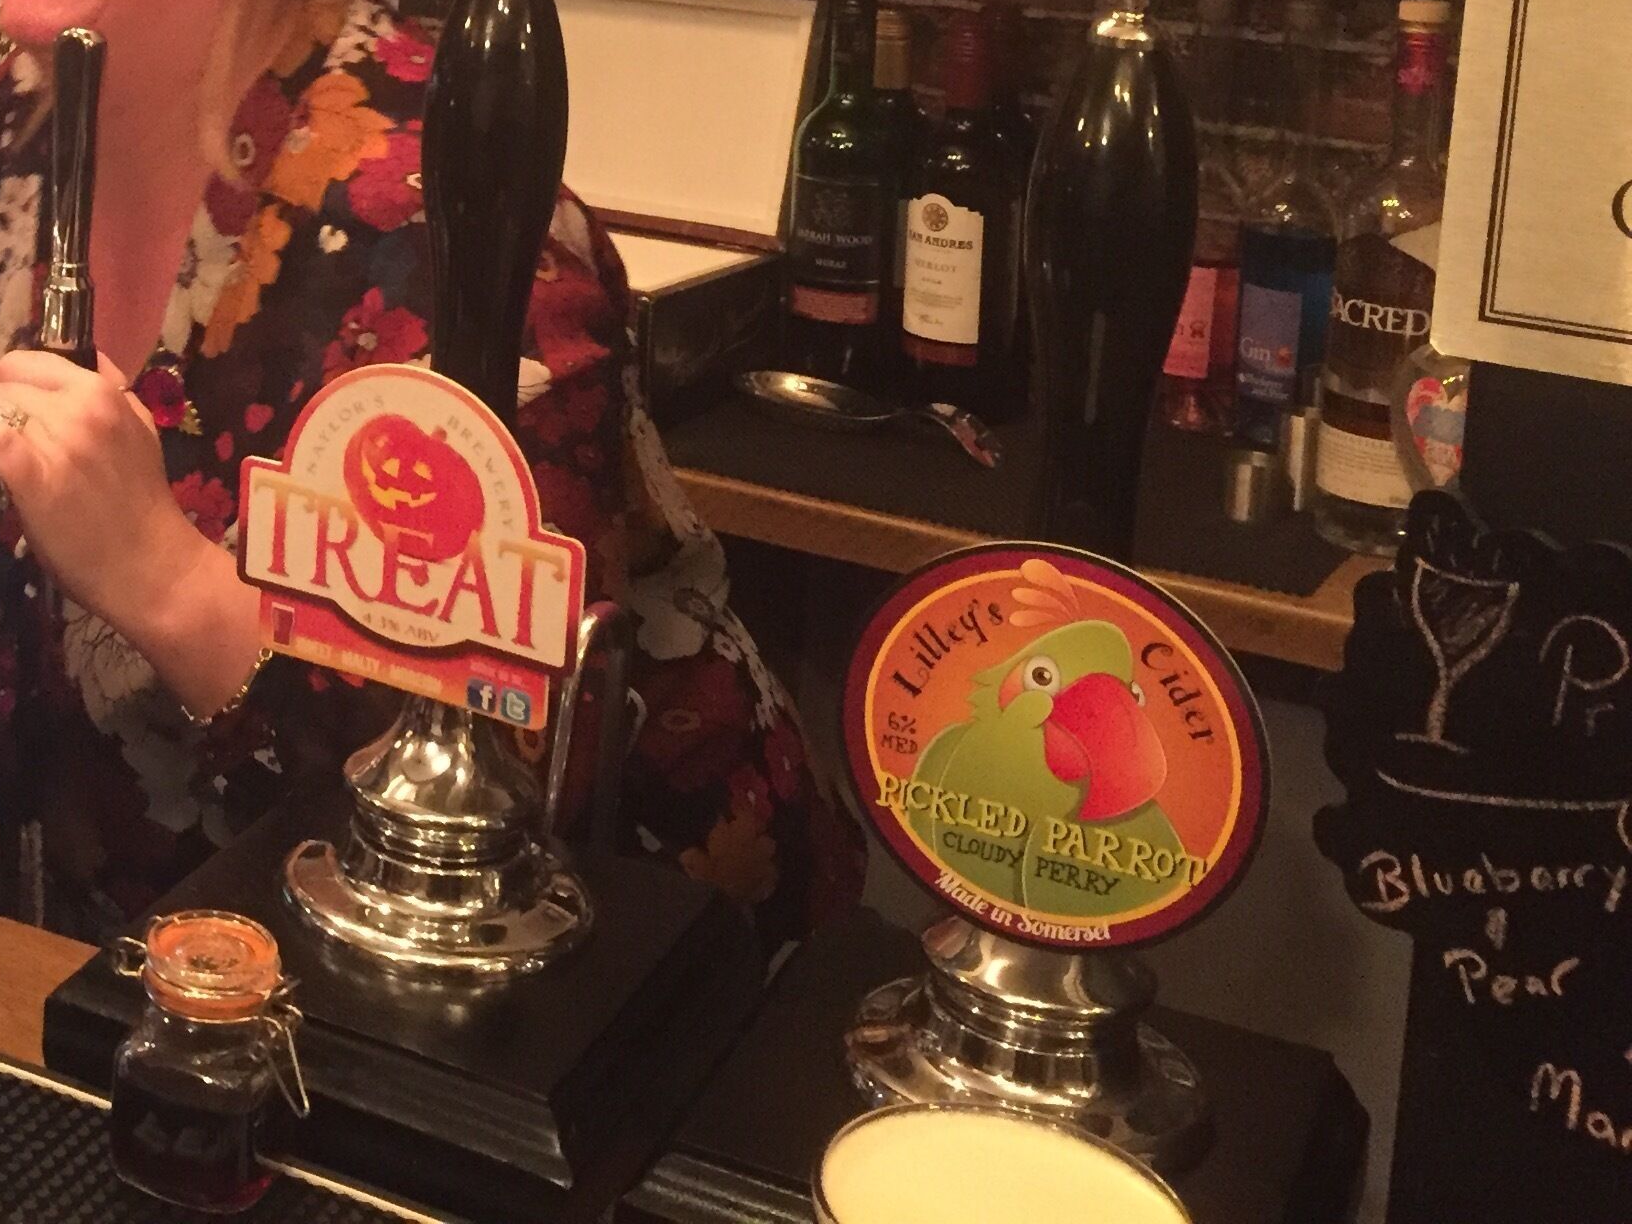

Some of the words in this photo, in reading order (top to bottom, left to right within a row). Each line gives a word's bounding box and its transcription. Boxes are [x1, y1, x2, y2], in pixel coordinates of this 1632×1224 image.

[836, 233, 873, 246] WOOD
[914, 258, 958, 274] MERLOT
[924, 235, 974, 251] ANDRES
[1330, 285, 1432, 339] ACRED
[1239, 336, 1272, 362] Gin
[446, 414, 513, 527] BREWERY
[254, 476, 566, 650] TREAT
[893, 598, 1004, 698] Lilley's
[1140, 640, 1215, 747] Cider
[881, 733, 918, 755] MED
[887, 711, 917, 735] 6%
[875, 771, 1028, 839] PICKLED
[1042, 814, 1211, 889] PARROT
[942, 830, 1025, 869] CLOUDY
[1035, 855, 1121, 896] PERRY
[934, 868, 989, 915] Made
[991, 906, 1013, 927] in
[1017, 911, 1111, 942] Somerset
[1442, 946, 1581, 1005] Pear
